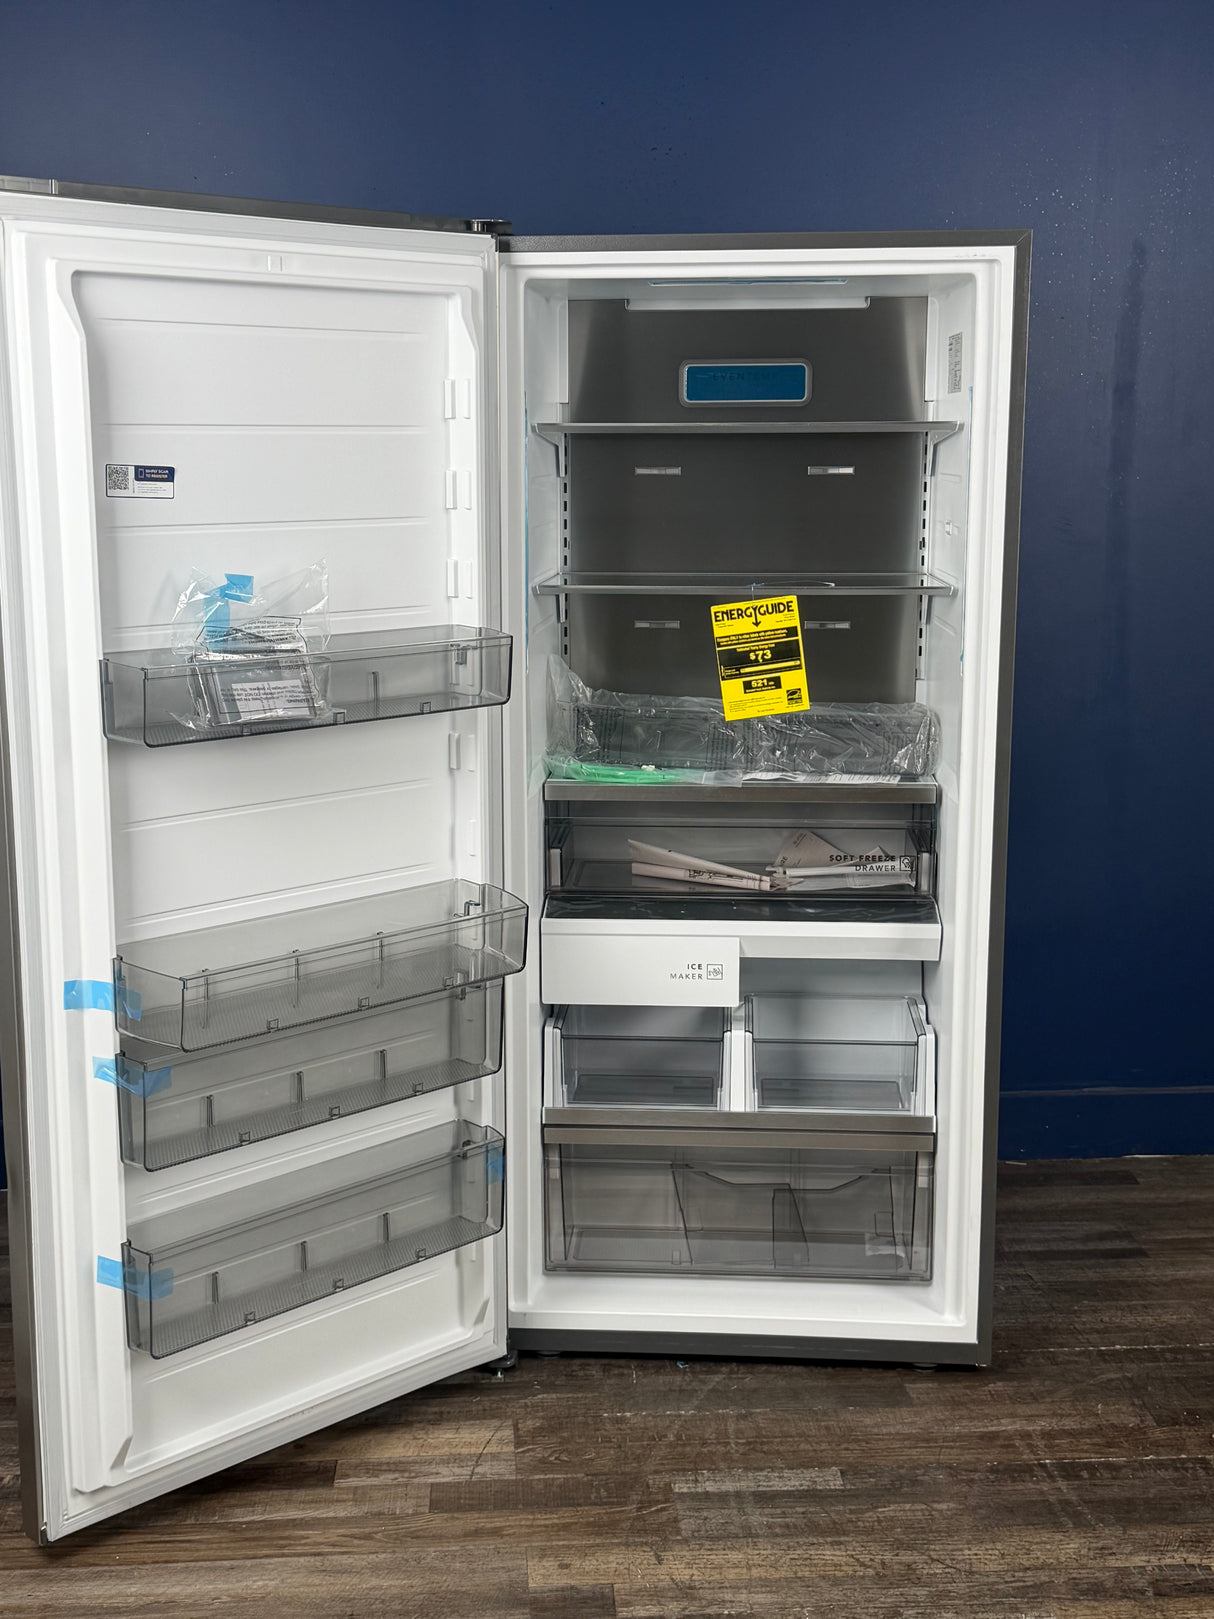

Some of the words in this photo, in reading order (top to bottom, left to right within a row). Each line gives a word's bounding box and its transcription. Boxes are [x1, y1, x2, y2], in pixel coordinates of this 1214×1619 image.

[714, 601, 794, 622] ENERGYGUIDE
[749, 650, 771, 662] $73
[751, 679, 767, 688] 521
